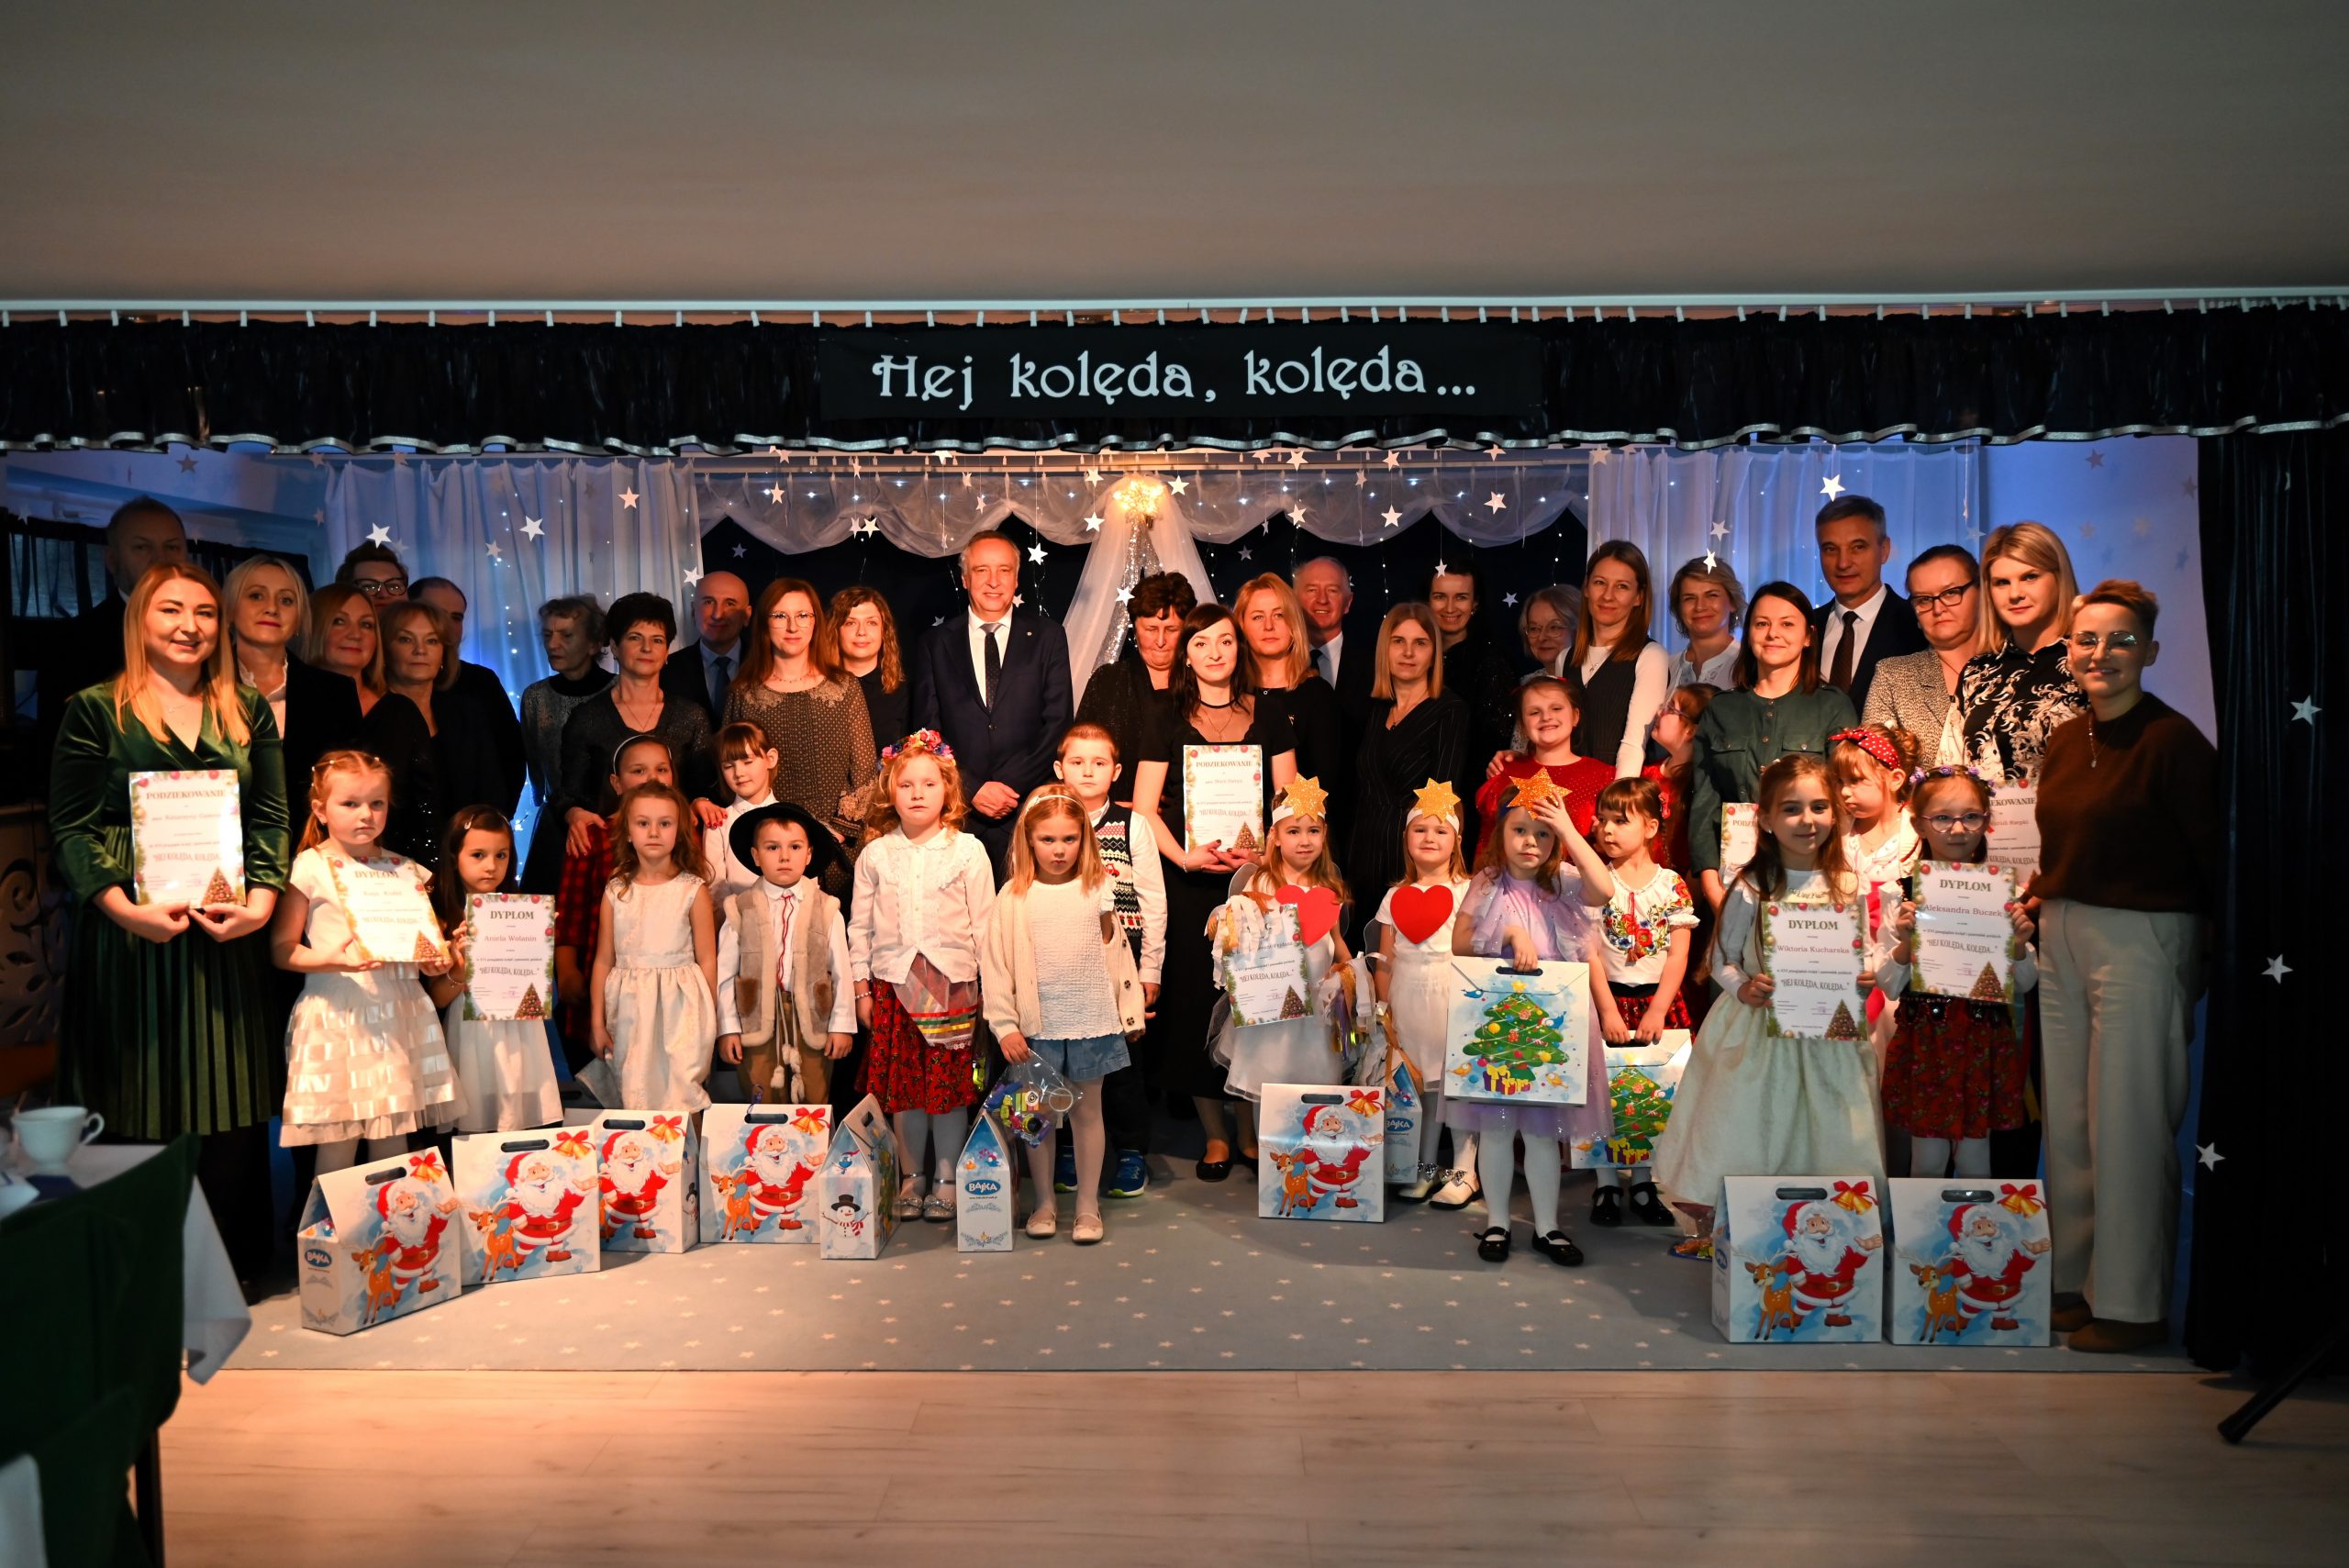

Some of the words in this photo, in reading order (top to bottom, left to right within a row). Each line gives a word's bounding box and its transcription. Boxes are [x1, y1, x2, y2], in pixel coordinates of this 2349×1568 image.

[872, 353, 974, 411] Hej
[1009, 350, 1217, 404] kolęda,
[1244, 345, 1476, 400] kolęda...
[1940, 879, 1991, 892] DYPLOM
[490, 910, 534, 919] DYPLOM
[1923, 904, 1970, 915] Aleksandra
[1973, 907, 2003, 917] Buczek
[1788, 919, 1838, 930] DYPLOM
[1777, 945, 1808, 953] Wiktoria
[969, 1182, 997, 1194] BAJKA
